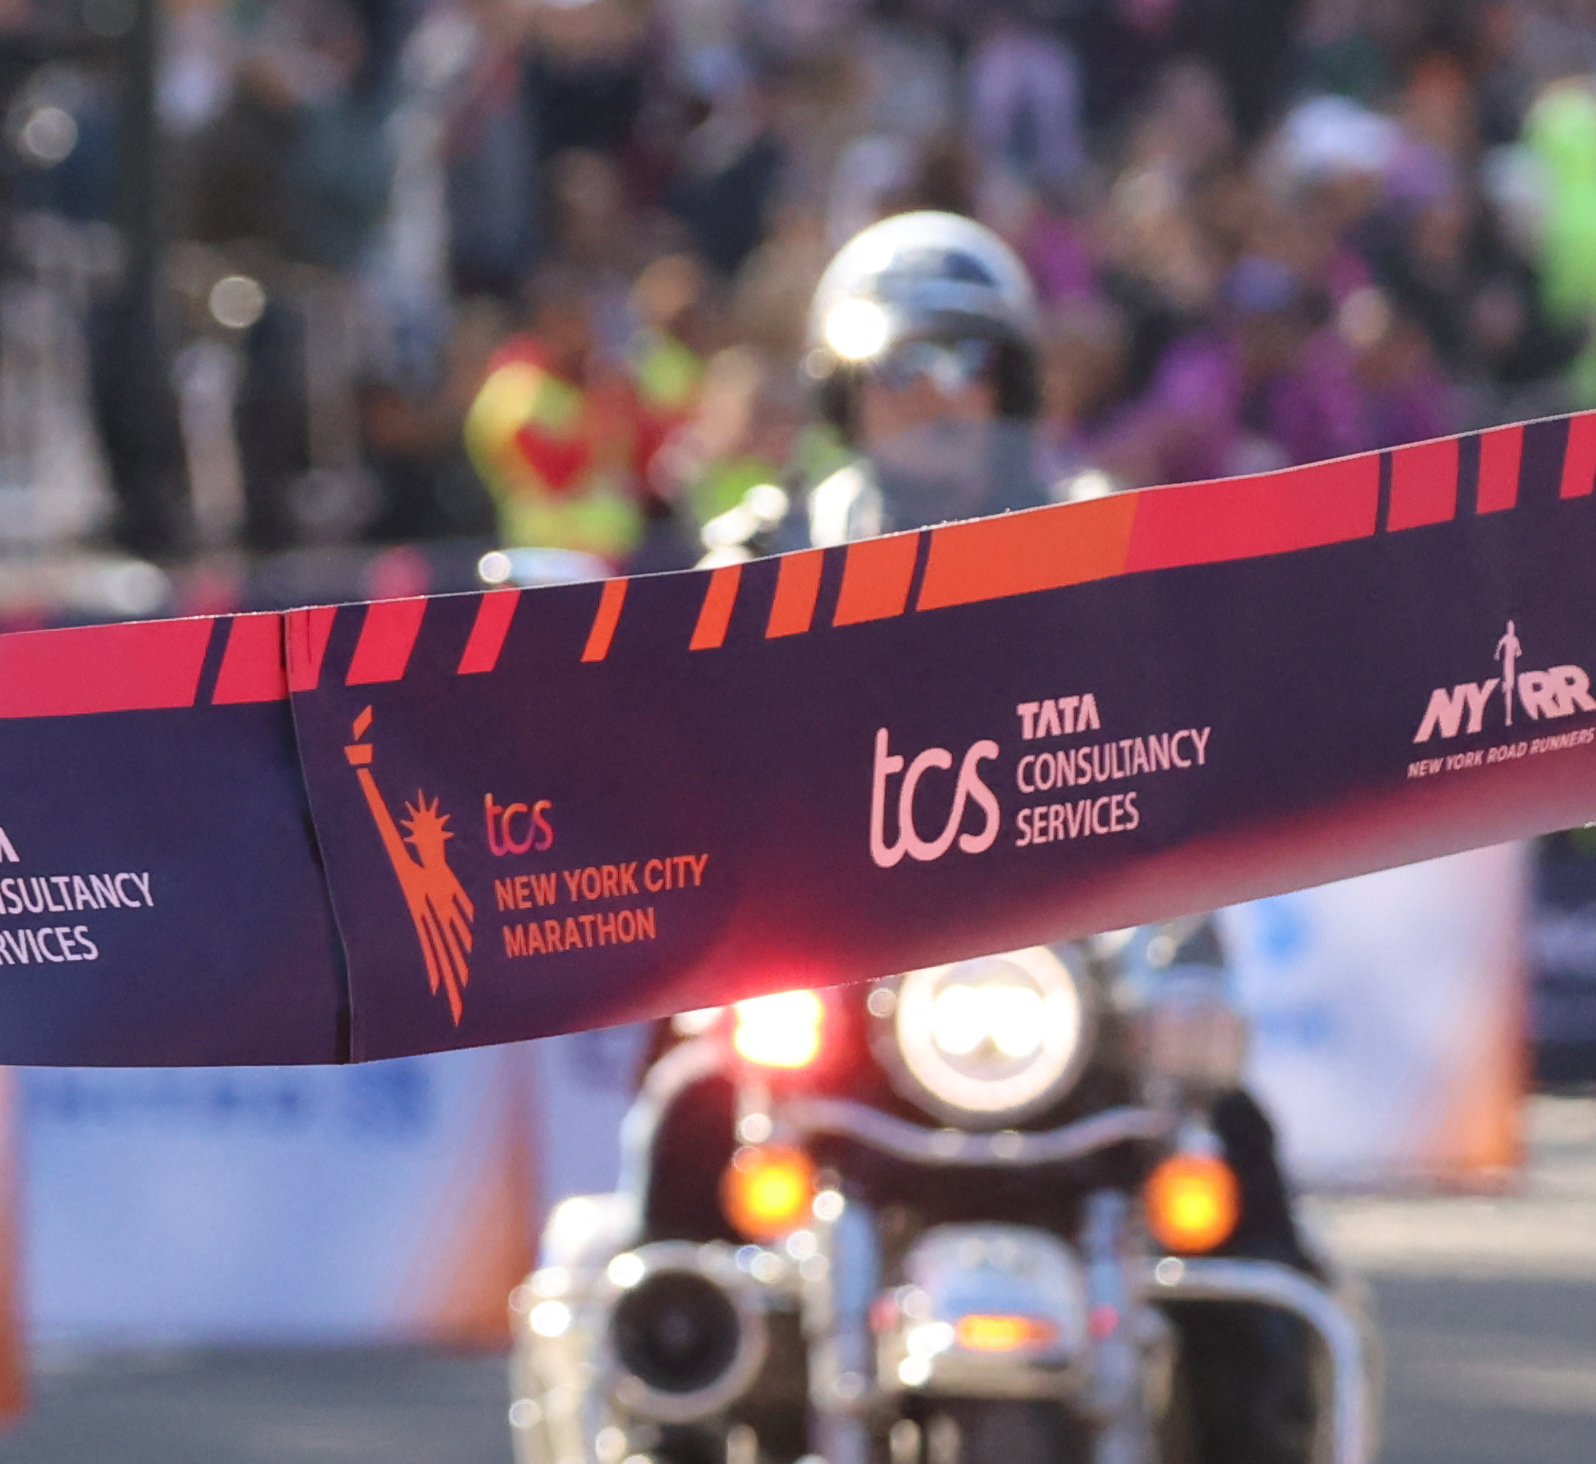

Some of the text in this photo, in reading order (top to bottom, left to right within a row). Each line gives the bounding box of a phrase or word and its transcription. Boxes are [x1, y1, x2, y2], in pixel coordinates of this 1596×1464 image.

[1016, 693, 1101, 740] TATA
[1413, 664, 1596, 744] NYRR
[1016, 727, 1212, 794] CONSULTANCY
[1407, 727, 1596, 779] NEW YORK ROAD RUNNERS
[484, 792, 556, 857] tcs
[870, 727, 1000, 868] tcs
[1015, 792, 1141, 847] SERVICES
[494, 853, 710, 912] NEW YORK CITY
[503, 907, 657, 959] MARATHON
